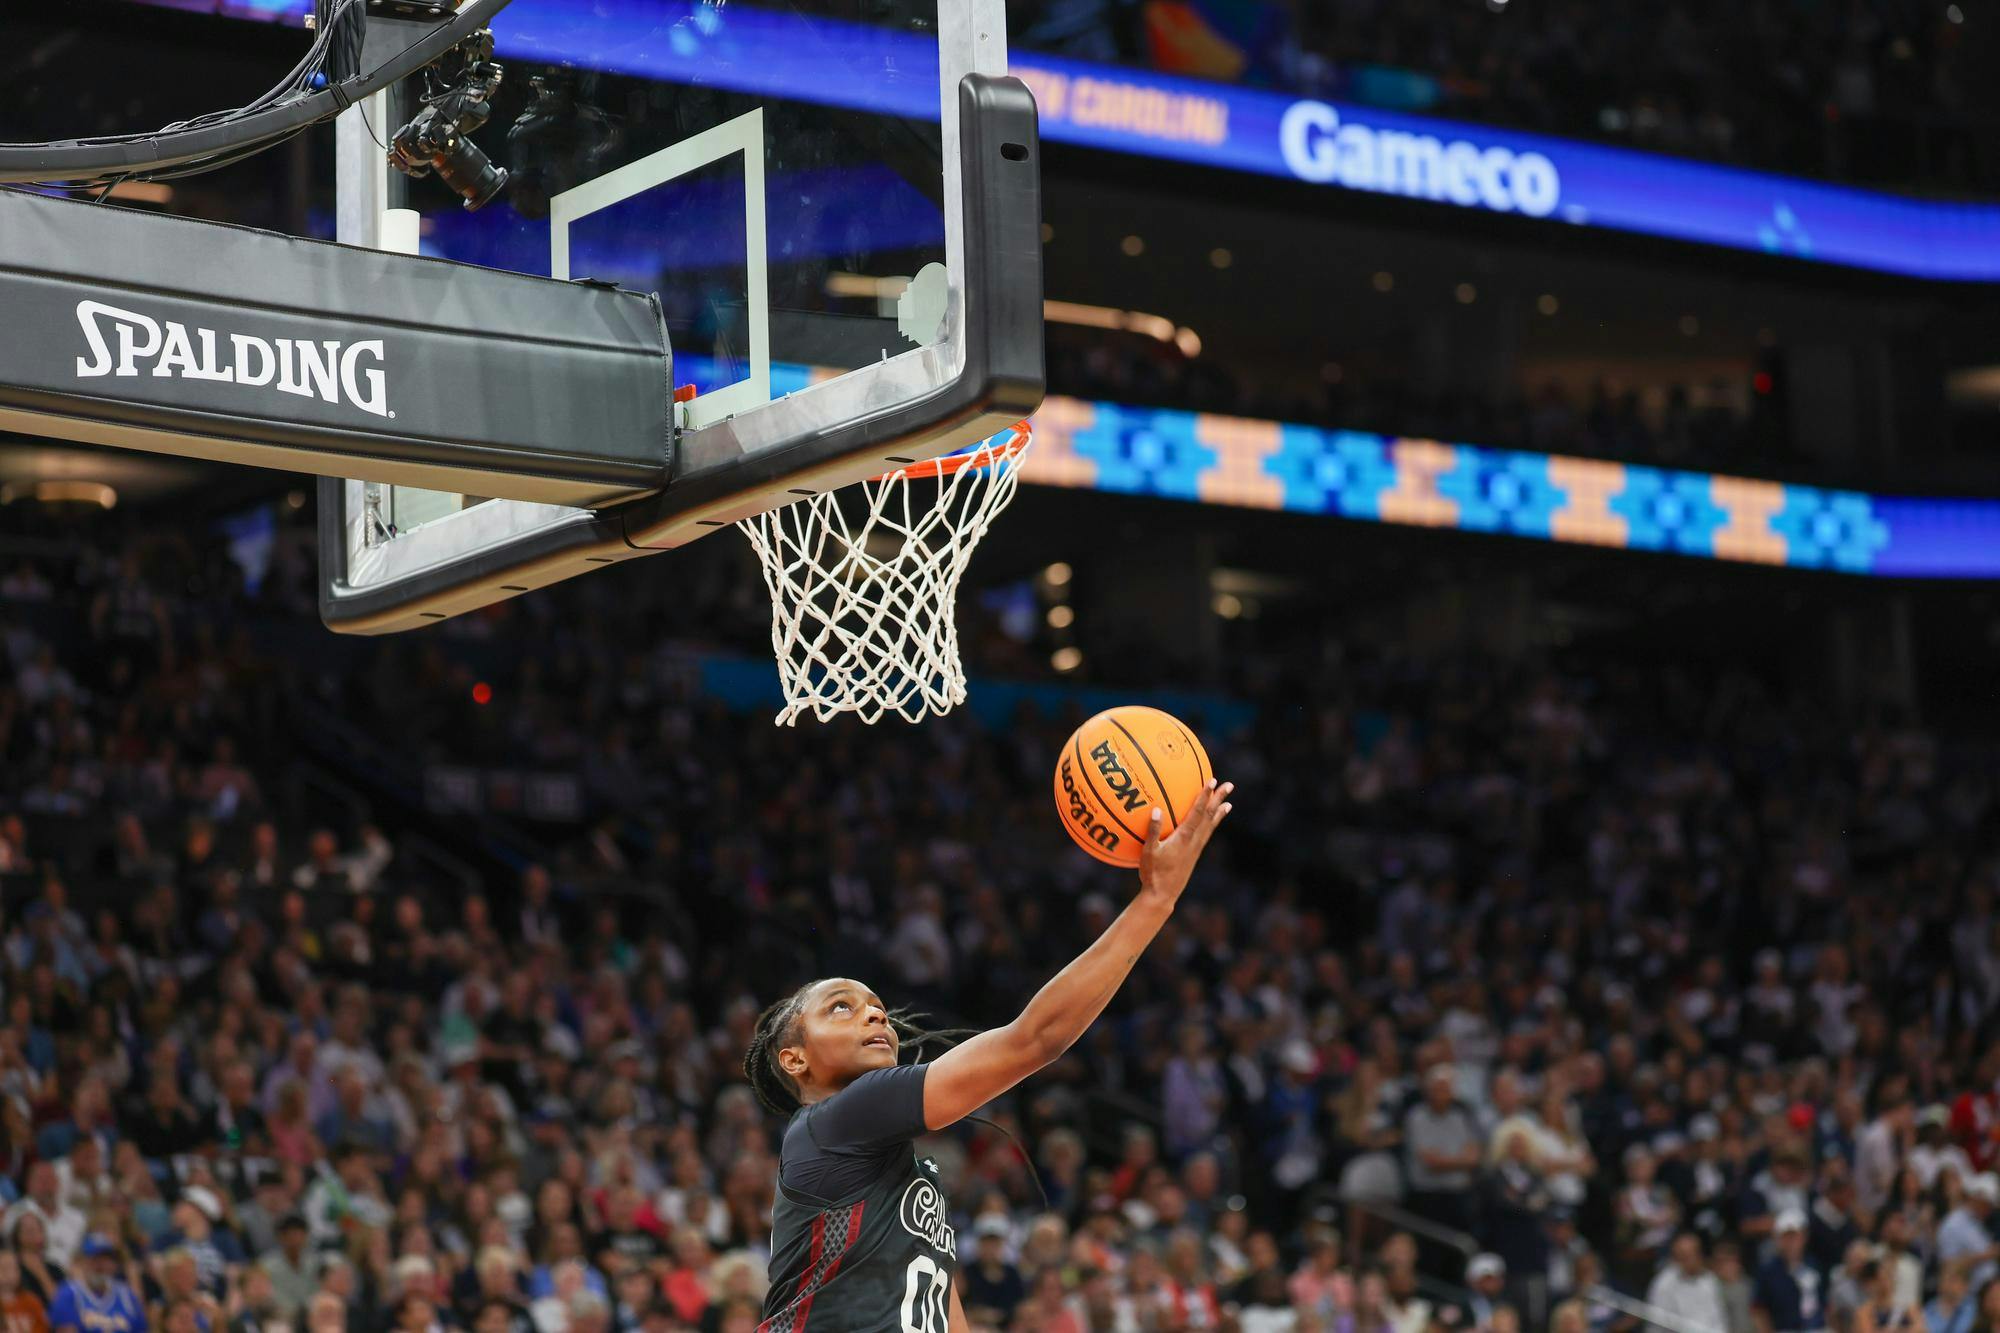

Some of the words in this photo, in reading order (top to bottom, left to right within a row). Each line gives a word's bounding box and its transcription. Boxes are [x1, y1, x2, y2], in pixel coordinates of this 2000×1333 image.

[1279, 100, 1560, 217] Gameco
[76, 300, 388, 417] SPALDING
[1061, 754, 1120, 851] Wilson
[1091, 740, 1147, 813] NCAA
[901, 1255, 948, 1333] 00
